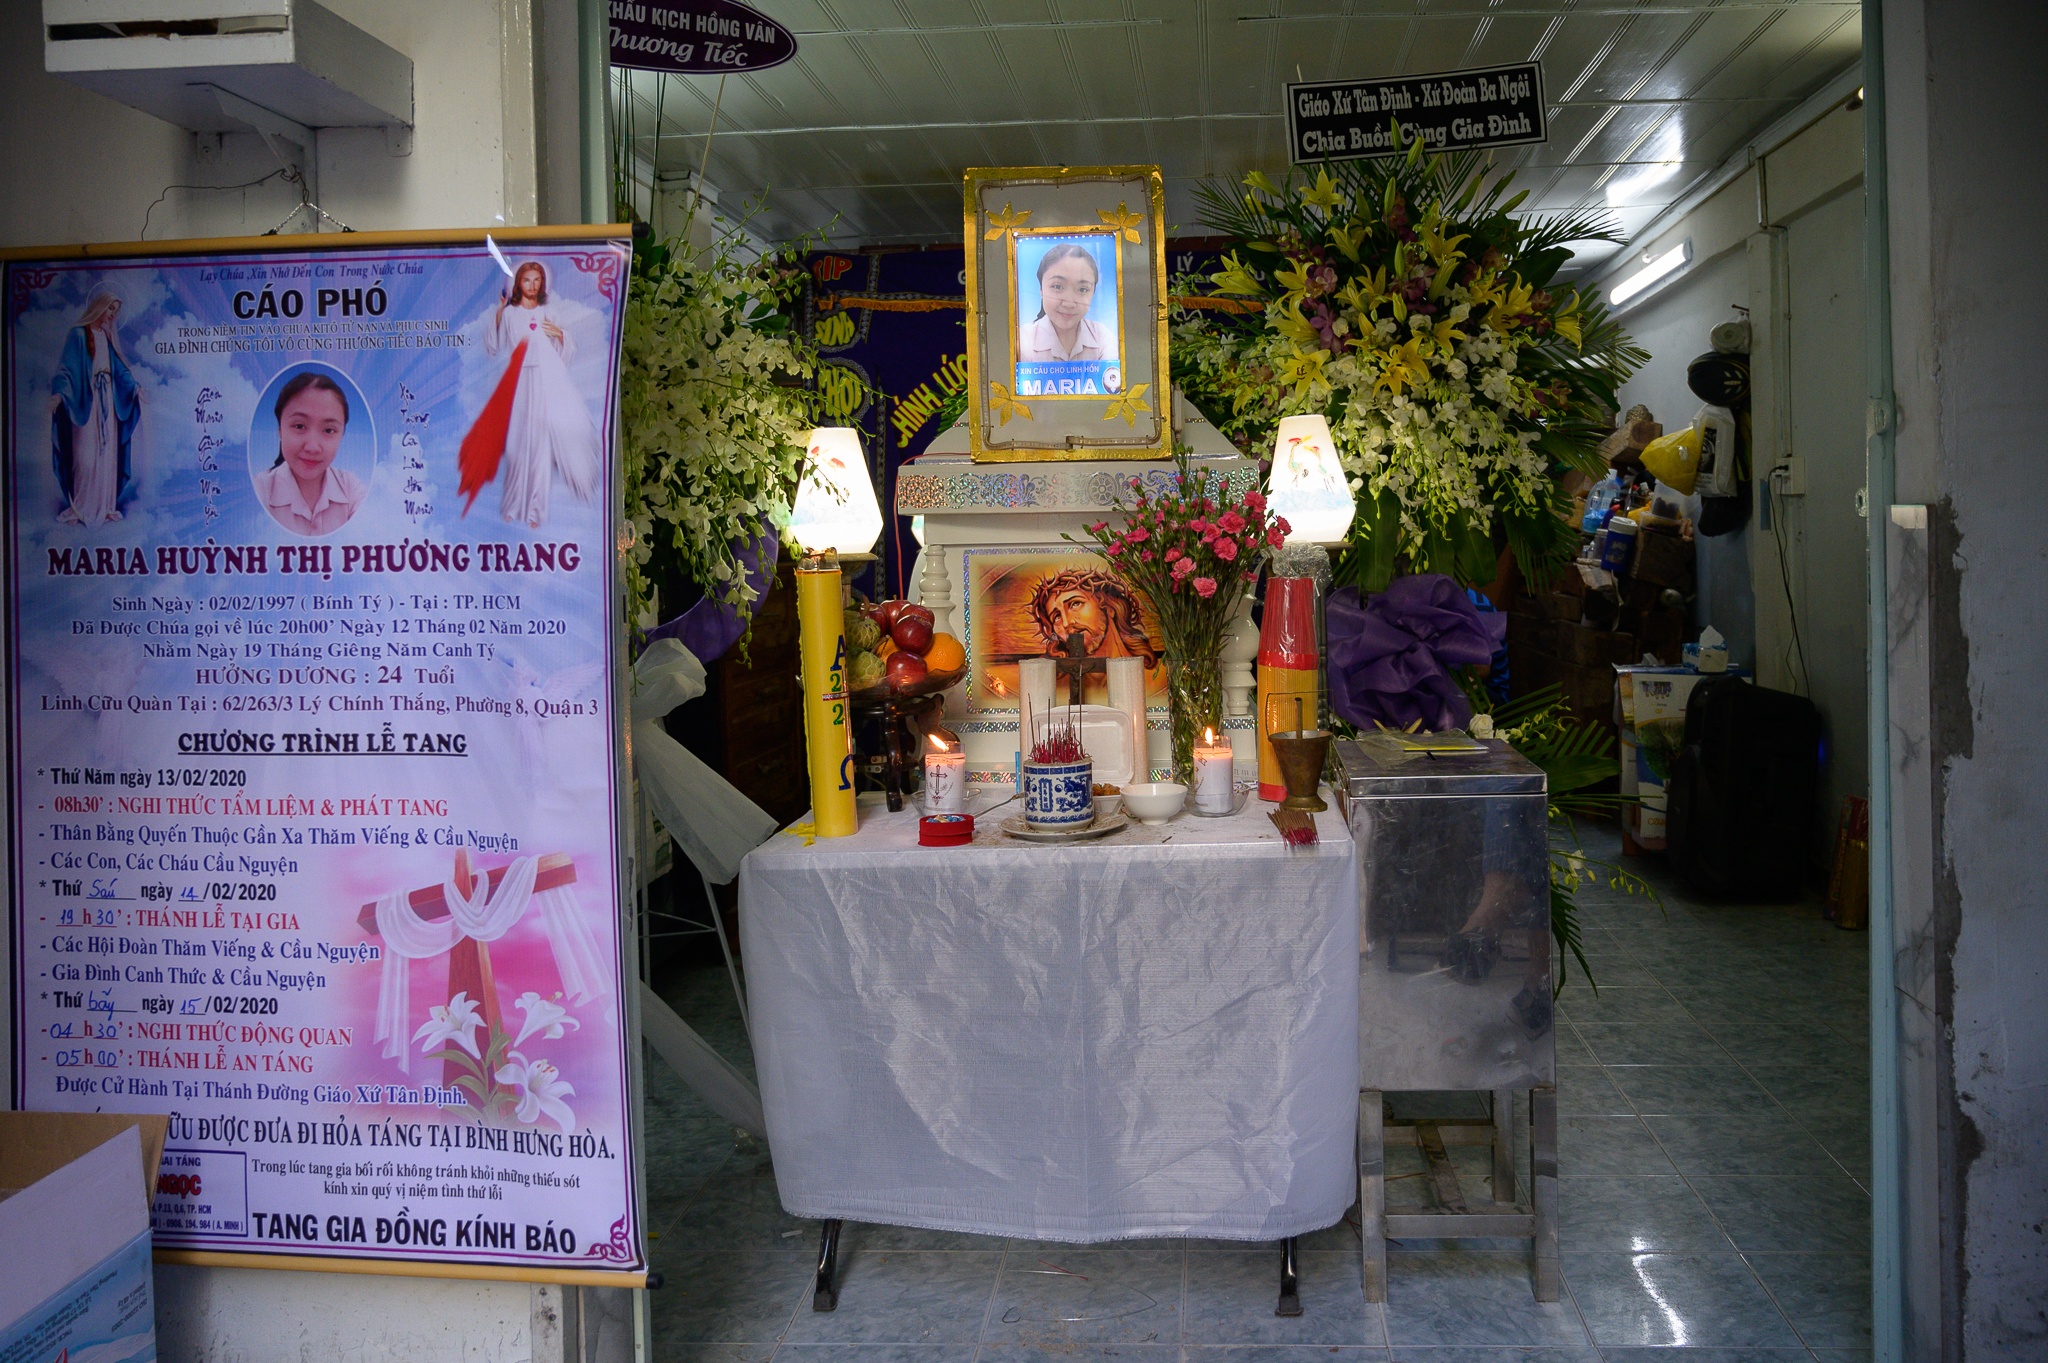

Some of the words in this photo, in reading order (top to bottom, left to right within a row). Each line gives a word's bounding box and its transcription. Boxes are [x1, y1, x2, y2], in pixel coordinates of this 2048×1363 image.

[652, 8, 690, 31] KỊCH
[696, 11, 740, 37] HỒNG
[745, 21, 775, 43] VÂN
[704, 41, 748, 66] Tiếc
[1300, 93, 1330, 118] Giáo
[1332, 90, 1351, 115] Xứ
[1353, 89, 1378, 113] Tân
[1380, 84, 1412, 116] Định
[1421, 83, 1441, 107] Xứ
[1443, 81, 1476, 104] Đoàn
[1479, 78, 1497, 101] Ba
[1499, 74, 1530, 106] Ngôi
[1303, 130, 1345, 153] Chia
[1350, 124, 1393, 149] Buồn
[1451, 118, 1484, 140] Gia
[1488, 112, 1531, 135] Đình
[200, 270, 217, 284] Lạy
[220, 269, 244, 280] Chúa
[270, 266, 290, 279] Nhớ
[292, 264, 311, 278] Đến
[315, 266, 334, 277] Con
[340, 265, 368, 278] Trong
[398, 262, 423, 274] Chúa
[1177, 252, 1193, 271] LÝ
[233, 283, 304, 319] CÁO
[318, 280, 387, 316] PHÓ
[1023, 378, 1098, 395] MARIA
[48, 547, 148, 575] MARIA
[157, 539, 268, 574] HUỲNH
[277, 546, 332, 580] THỊ
[342, 538, 471, 573] PHƯƠNG
[478, 544, 581, 572] TRANG
[112, 597, 146, 611] Sinh
[152, 596, 193, 613] Ngày
[209, 596, 295, 610] 02/02/1997
[360, 595, 381, 612] Tý
[410, 595, 438, 612] Tại
[482, 595, 520, 609] HCM
[72, 621, 94, 634] Đã
[100, 620, 141, 637] Được
[146, 620, 189, 634] Chúa
[195, 621, 218, 637] gọi
[225, 617, 242, 634] về
[248, 620, 273, 634] lúc
[340, 620, 385, 636] Ngày
[392, 620, 410, 633] 12
[415, 619, 465, 636] Tháng
[469, 620, 485, 633] 02
[490, 619, 522, 634] Năm
[527, 620, 566, 634] 2020
[196, 664, 271, 684] HƯỞNG
[278, 668, 357, 684] DƯƠNG
[377, 666, 402, 684] 24
[414, 665, 455, 684] Tuổi
[41, 695, 82, 710] Linh
[87, 694, 122, 710] Cữu
[127, 695, 172, 713] Quàn
[178, 695, 206, 713] Tại
[223, 696, 293, 711] 62/263/3
[299, 695, 321, 714] Lý
[329, 694, 383, 711] Chính
[390, 692, 450, 714] Thắng,
[456, 695, 512, 717] Phường
[534, 699, 583, 717] Quận
[589, 700, 598, 714] 3
[178, 729, 275, 751] CHƯƠNG
[282, 728, 360, 752] TRÌNH
[367, 722, 395, 752] LỄ
[403, 733, 467, 752] TANG
[51, 768, 81, 785] Thứ
[84, 768, 115, 785] Năm
[120, 770, 151, 788] ngày
[158, 769, 246, 787] 13/02/2020
[118, 797, 161, 813] NGHI
[166, 795, 216, 814] THỨC
[221, 789, 261, 815] TẨM
[266, 795, 315, 818] LIỆM
[340, 795, 392, 815] PHÁT
[398, 799, 448, 816] TANG
[51, 825, 91, 841] Thân
[96, 821, 134, 845] Bằng
[139, 825, 187, 847] Quyến
[192, 826, 238, 846] Thuộc
[244, 825, 276, 844] Gần
[282, 828, 301, 844] Xa
[308, 828, 355, 844] Thăm
[361, 825, 409, 848] Viếng
[434, 825, 464, 846] Cầu
[467, 830, 518, 853] Nguyện
[198, 1115, 249, 1146] ĐƯỢC
[255, 1119, 292, 1144] ĐƯA
[298, 1122, 317, 1145] ĐI
[323, 1115, 362, 1146] HỎA
[369, 1117, 421, 1147] TÁNG
[428, 1125, 460, 1153] TẠI
[466, 1119, 508, 1151] BÌNH
[513, 1129, 563, 1158] HƯNG
[569, 1128, 614, 1159] HÒA.
[176, 1154, 201, 1166] TÁNG
[252, 1159, 286, 1175] Trong
[289, 1160, 305, 1174] lúc
[309, 1164, 333, 1178] tang
[335, 1163, 351, 1178] gia
[355, 1159, 373, 1176] bối
[376, 1160, 393, 1176] rối
[397, 1163, 432, 1180] không
[435, 1164, 468, 1179] tránh
[471, 1165, 494, 1181] khỏi
[498, 1168, 530, 1187] những
[533, 1172, 560, 1187] thiếu
[563, 1174, 580, 1188] sót
[324, 1181, 348, 1196] kính
[351, 1182, 369, 1196] xin
[372, 1184, 392, 1199] quý
[396, 1185, 406, 1199] vị
[408, 1184, 438, 1199] niệm
[442, 1183, 463, 1198] tình
[467, 1183, 486, 1199] thứ
[489, 1185, 502, 1201] lỗi
[252, 1212, 318, 1240] TANG
[327, 1215, 367, 1243] GIA
[376, 1206, 446, 1247] ĐỒNG
[456, 1214, 515, 1250] KÍNH
[526, 1220, 576, 1254] BÁO
